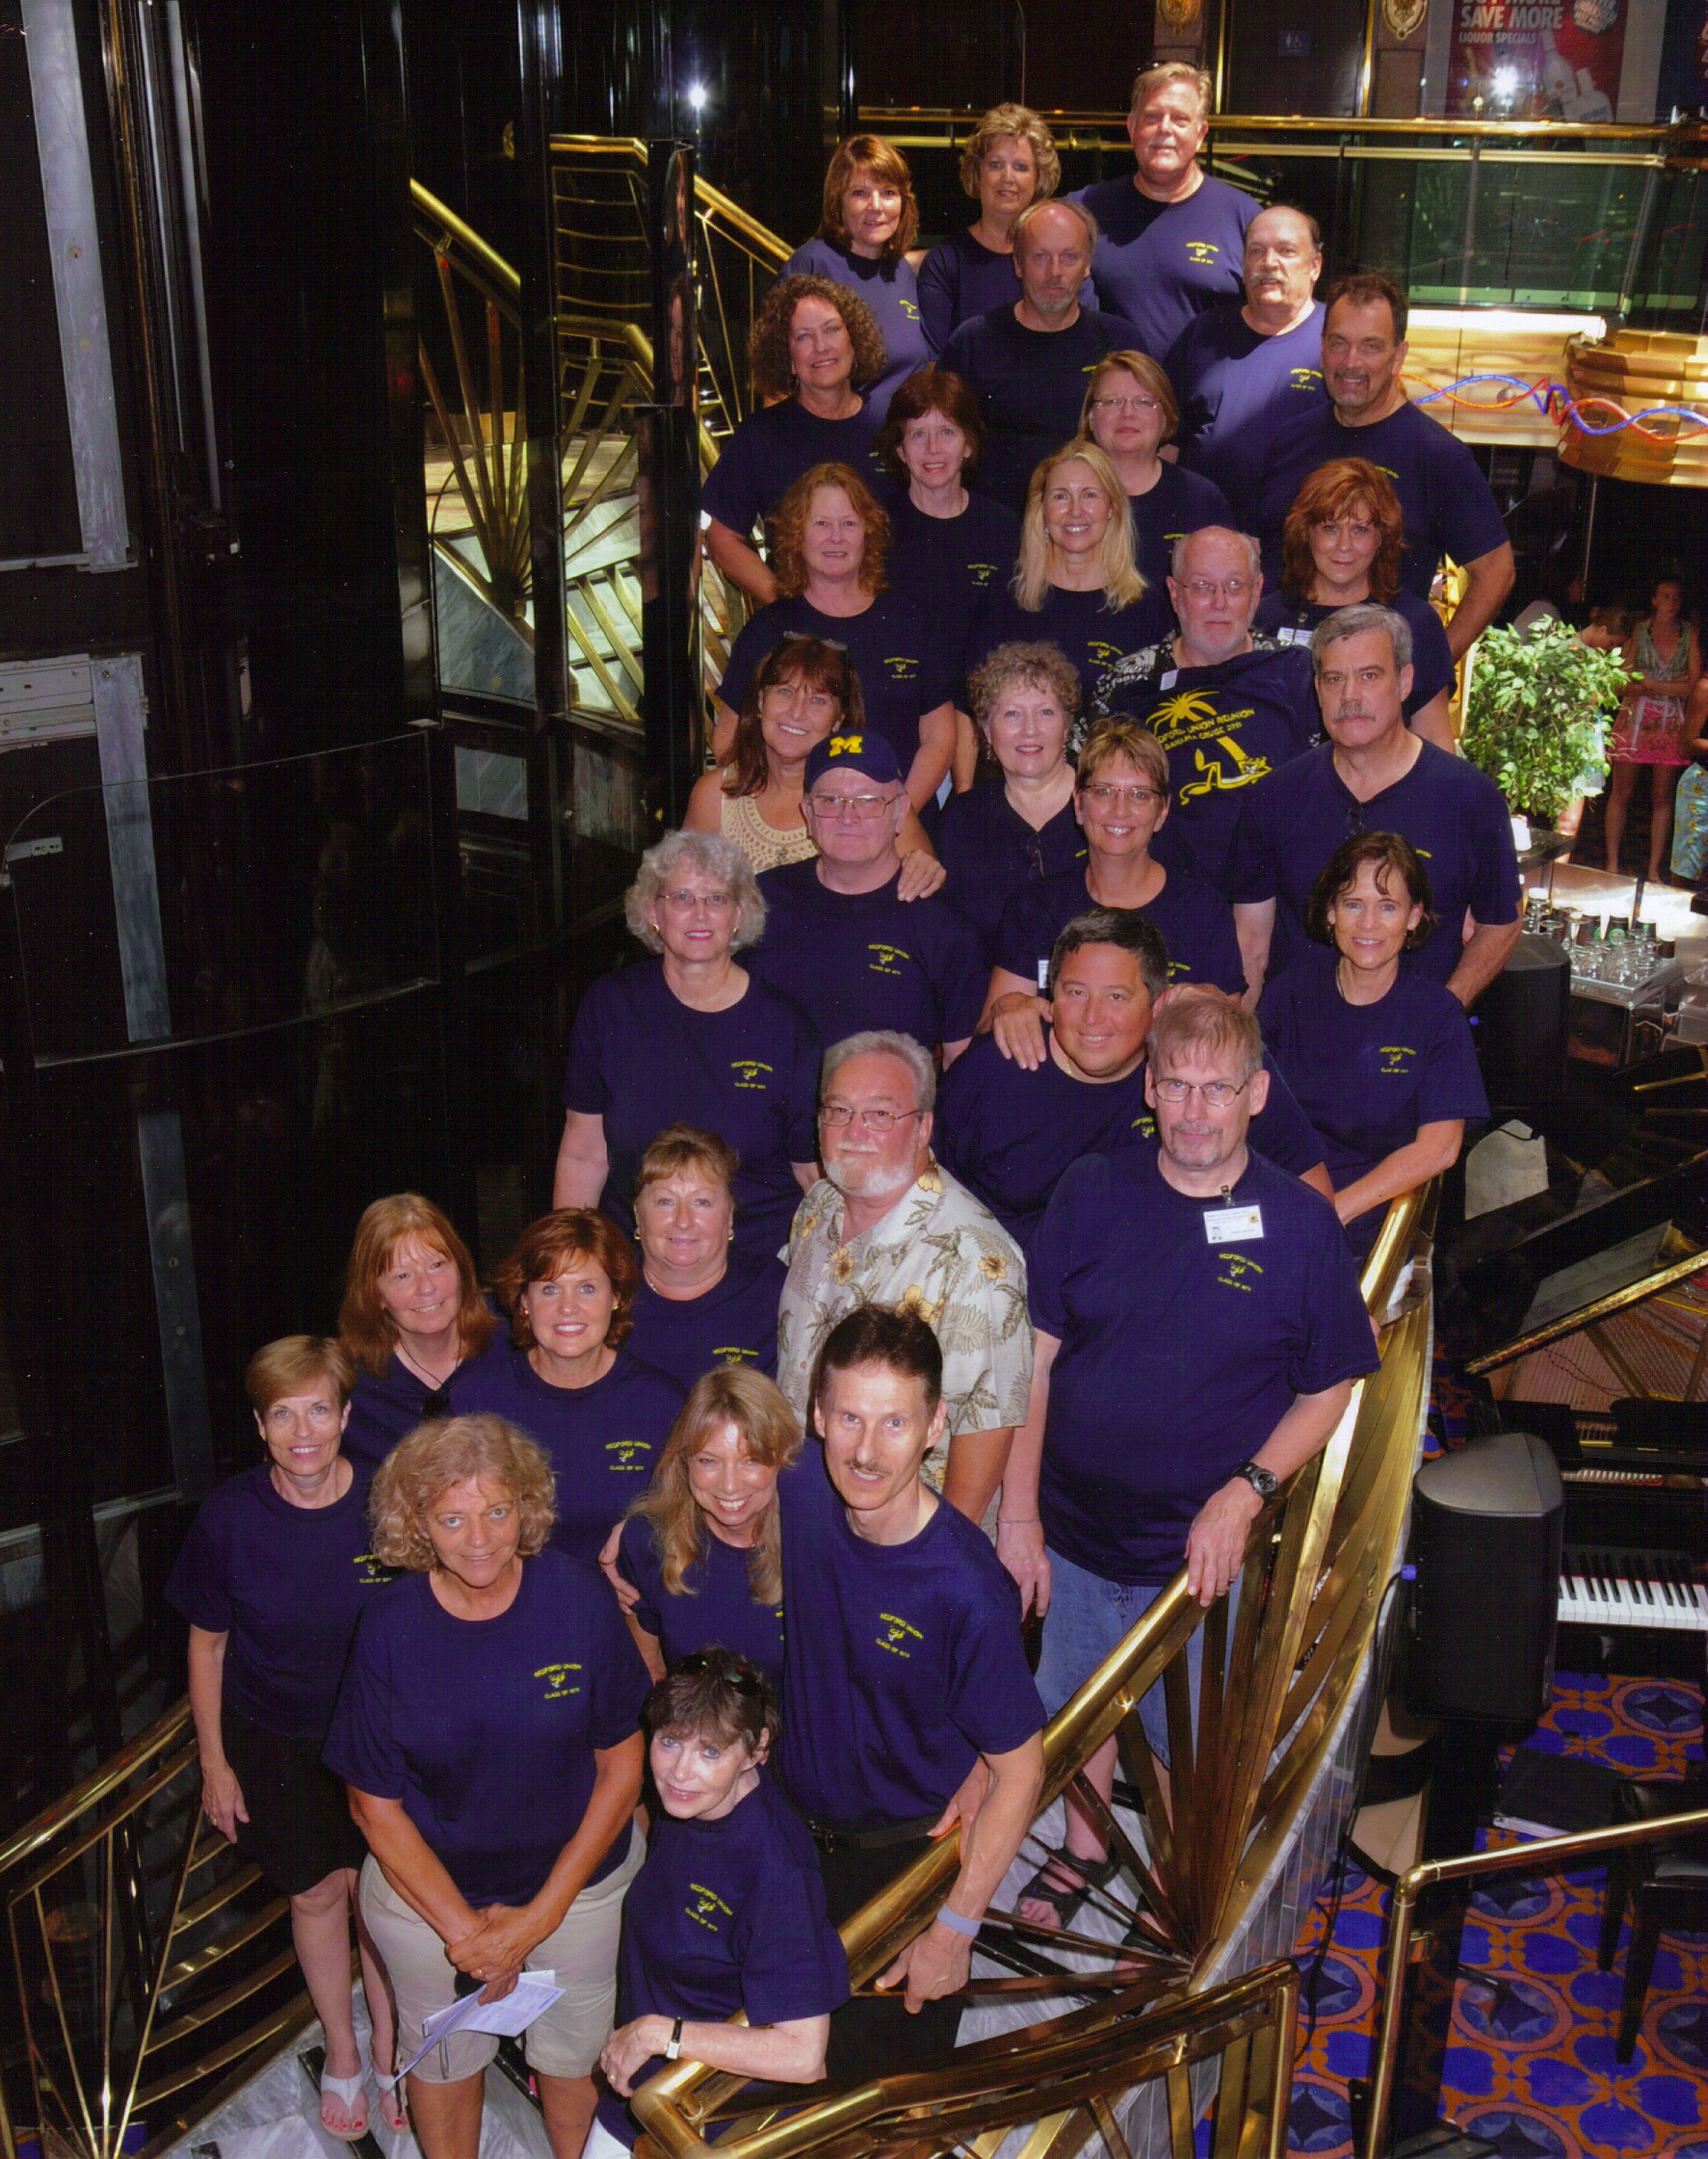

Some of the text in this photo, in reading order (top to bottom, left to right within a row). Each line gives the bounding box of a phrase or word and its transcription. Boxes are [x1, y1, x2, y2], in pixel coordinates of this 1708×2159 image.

[1461, 6, 1505, 28] SAVE
[1508, 6, 1564, 28] MORE
[1459, 31, 1537, 44] LIQUOR SPECIALS
[1187, 718, 1215, 733] UNION
[1216, 708, 1255, 724] REUNION
[829, 736, 863, 757] M
[1164, 735, 1198, 750] BAHAMA
